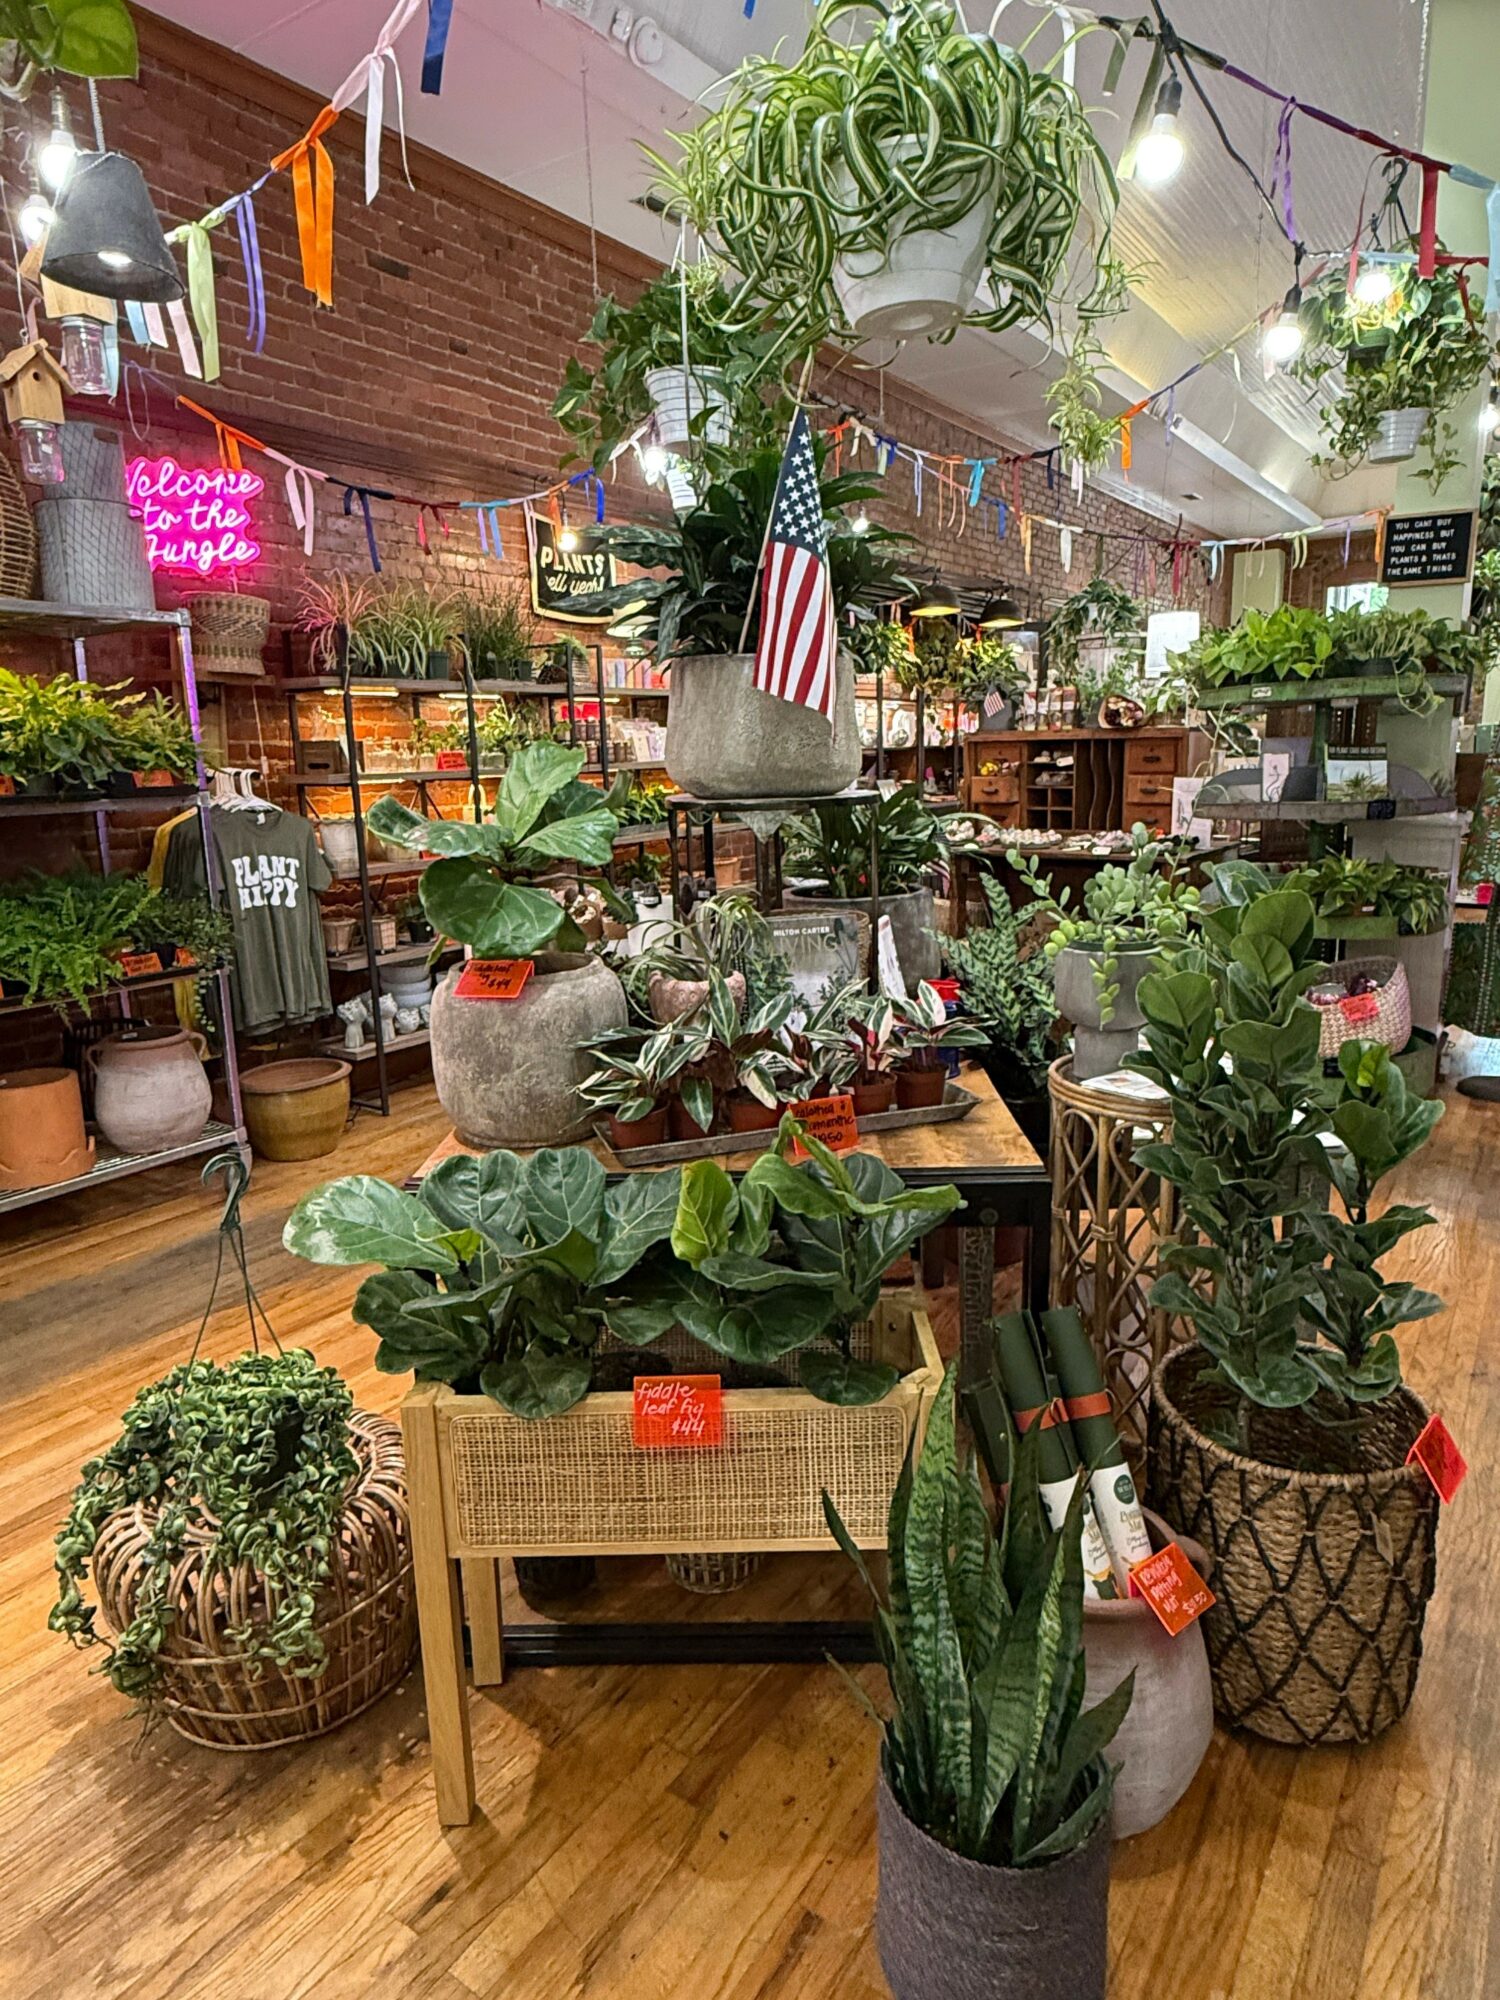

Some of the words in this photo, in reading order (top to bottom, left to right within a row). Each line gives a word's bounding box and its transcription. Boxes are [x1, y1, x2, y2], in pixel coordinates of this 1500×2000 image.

[141, 498, 182, 531] to
[184, 498, 248, 531] the
[1395, 521, 1410, 531] YOU
[1437, 518, 1453, 527] BUY
[1393, 531, 1434, 541] HAPPINESS
[1440, 529, 1455, 538] BUT
[1390, 545, 1405, 553] YOU
[1411, 543, 1426, 552] CAN
[1432, 542, 1447, 550] BUY
[1390, 555, 1419, 565] PLANTS
[1387, 567, 1401, 576] THE
[1403, 566, 1422, 575] SAME
[1426, 564, 1453, 574] THING
[231, 855, 300, 887] PLANT
[238, 877, 300, 911] HIPPY
[773, 928, 800, 937] HILTON
[801, 926, 830, 935] CARTER
[637, 1381, 697, 1401] fiddle
[641, 1398, 678, 1417] leaf
[680, 1398, 705, 1422] fig
[671, 1416, 706, 1438] $44
